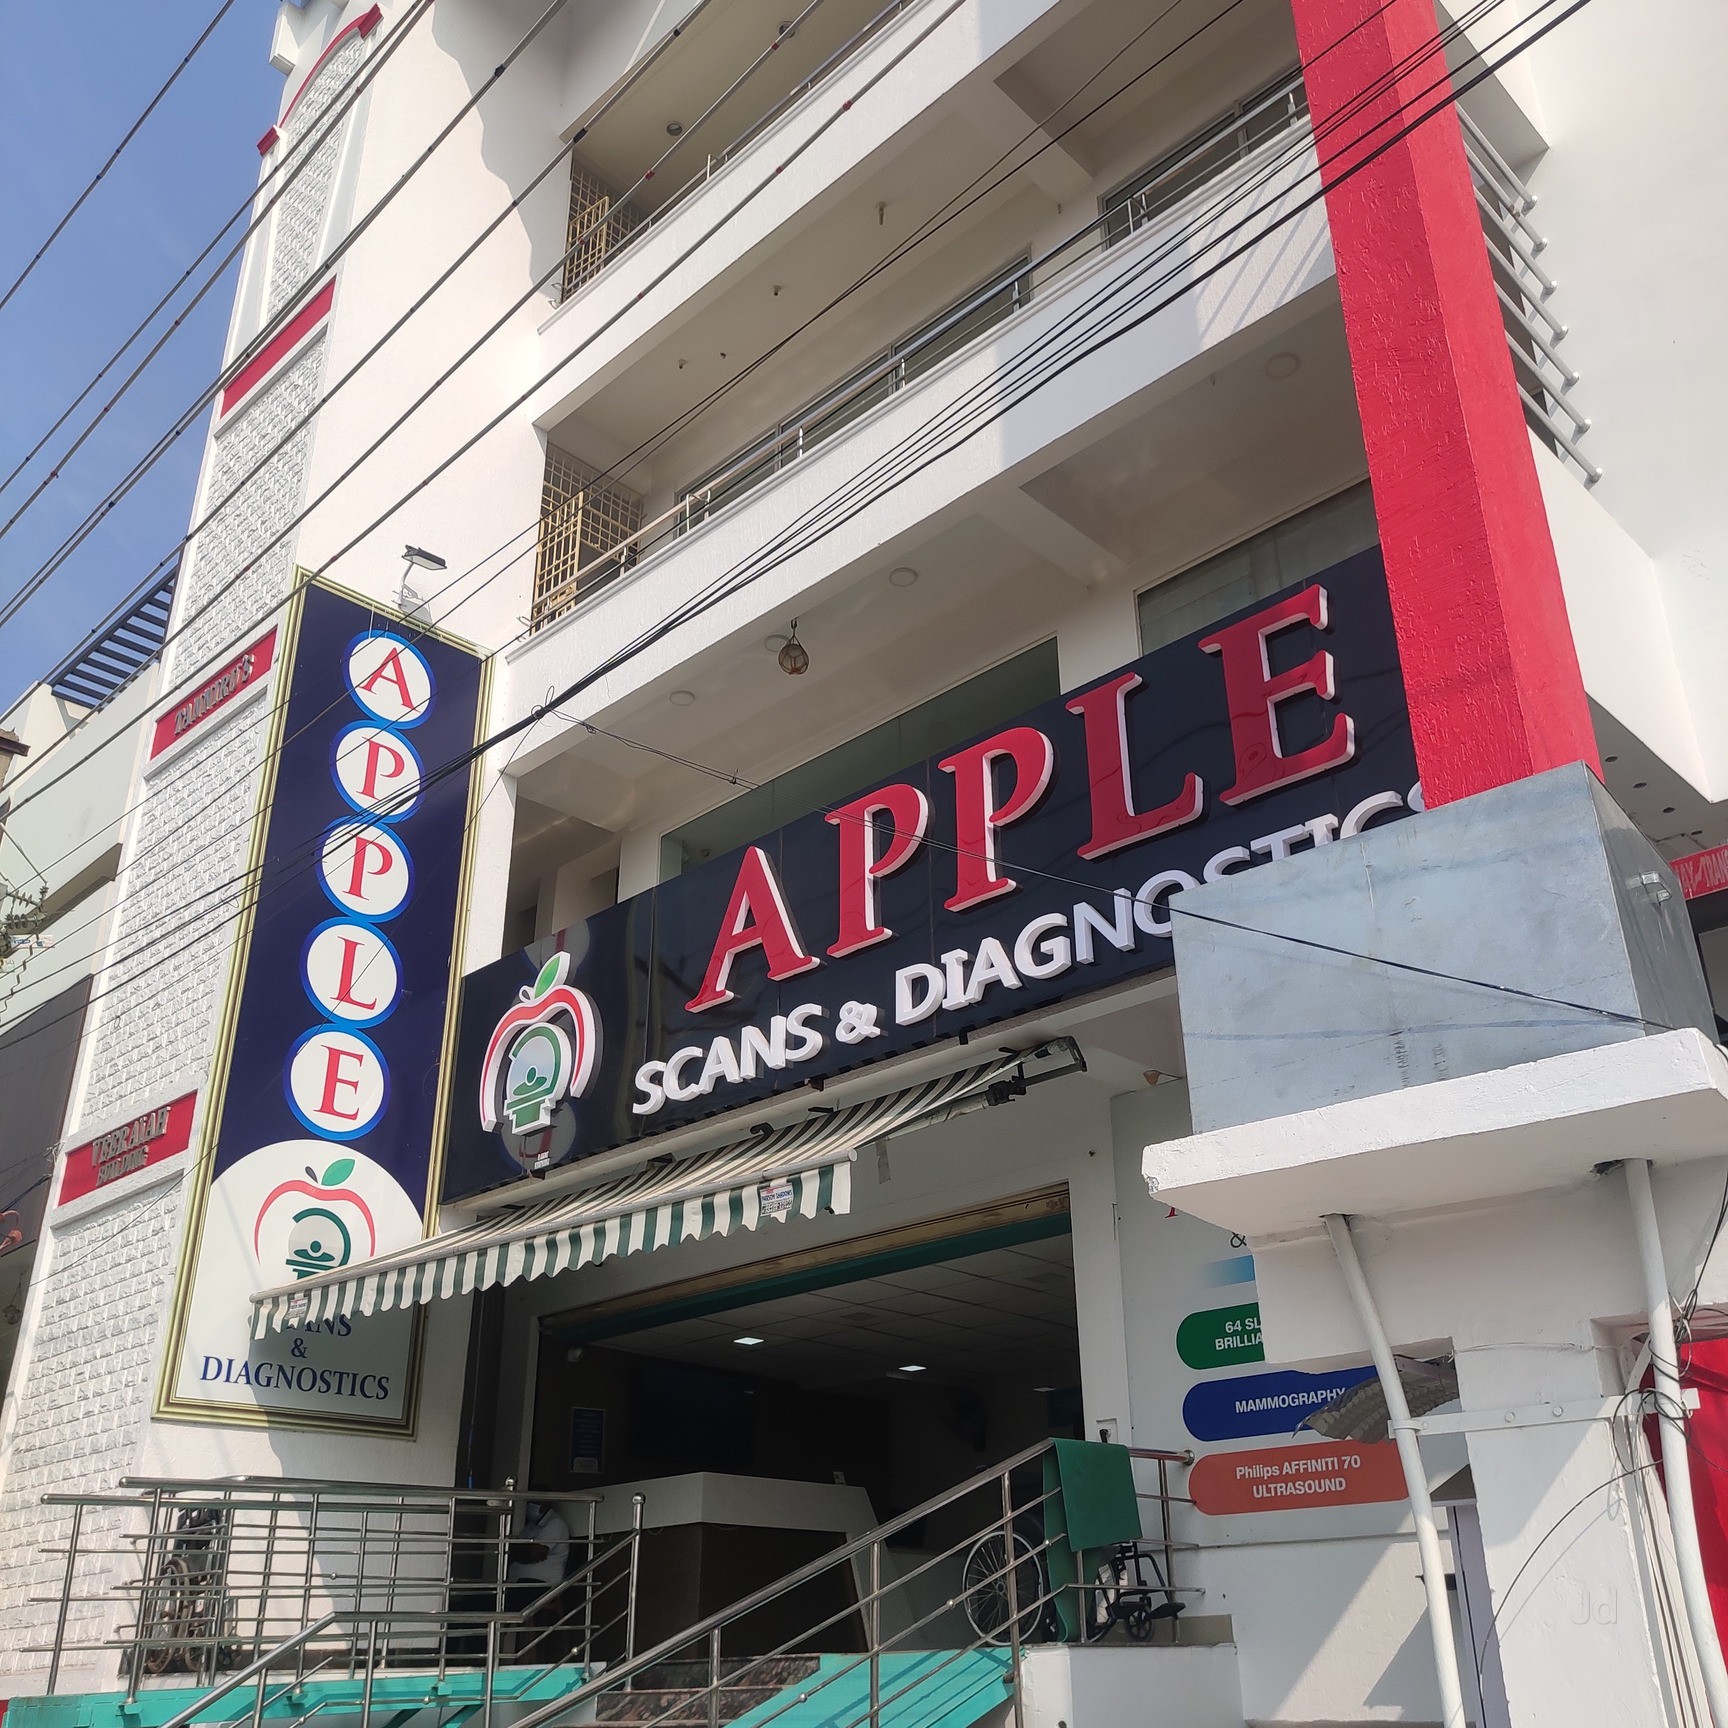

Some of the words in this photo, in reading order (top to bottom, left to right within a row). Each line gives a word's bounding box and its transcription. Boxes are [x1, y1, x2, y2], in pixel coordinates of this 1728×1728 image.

[685, 584, 1356, 1015] APPLE
[313, 646, 421, 1121] APPLE
[632, 1003, 824, 1115] SCANS
[835, 1000, 881, 1044] &
[1225, 1320, 1242, 1333] 64
[1245, 1317, 1262, 1330] SL
[291, 1337, 308, 1358] &
[1215, 1332, 1263, 1350] BRILLIA
[200, 1355, 390, 1400] DIAGNOSTICS
[1235, 1387, 1346, 1413] MAMMOGRAPHY
[1236, 1464, 1280, 1480] Philips
[1282, 1457, 1339, 1475] AFFINITI
[1341, 1455, 1361, 1470] 70
[1253, 1478, 1346, 1498] ULTRASOUND
